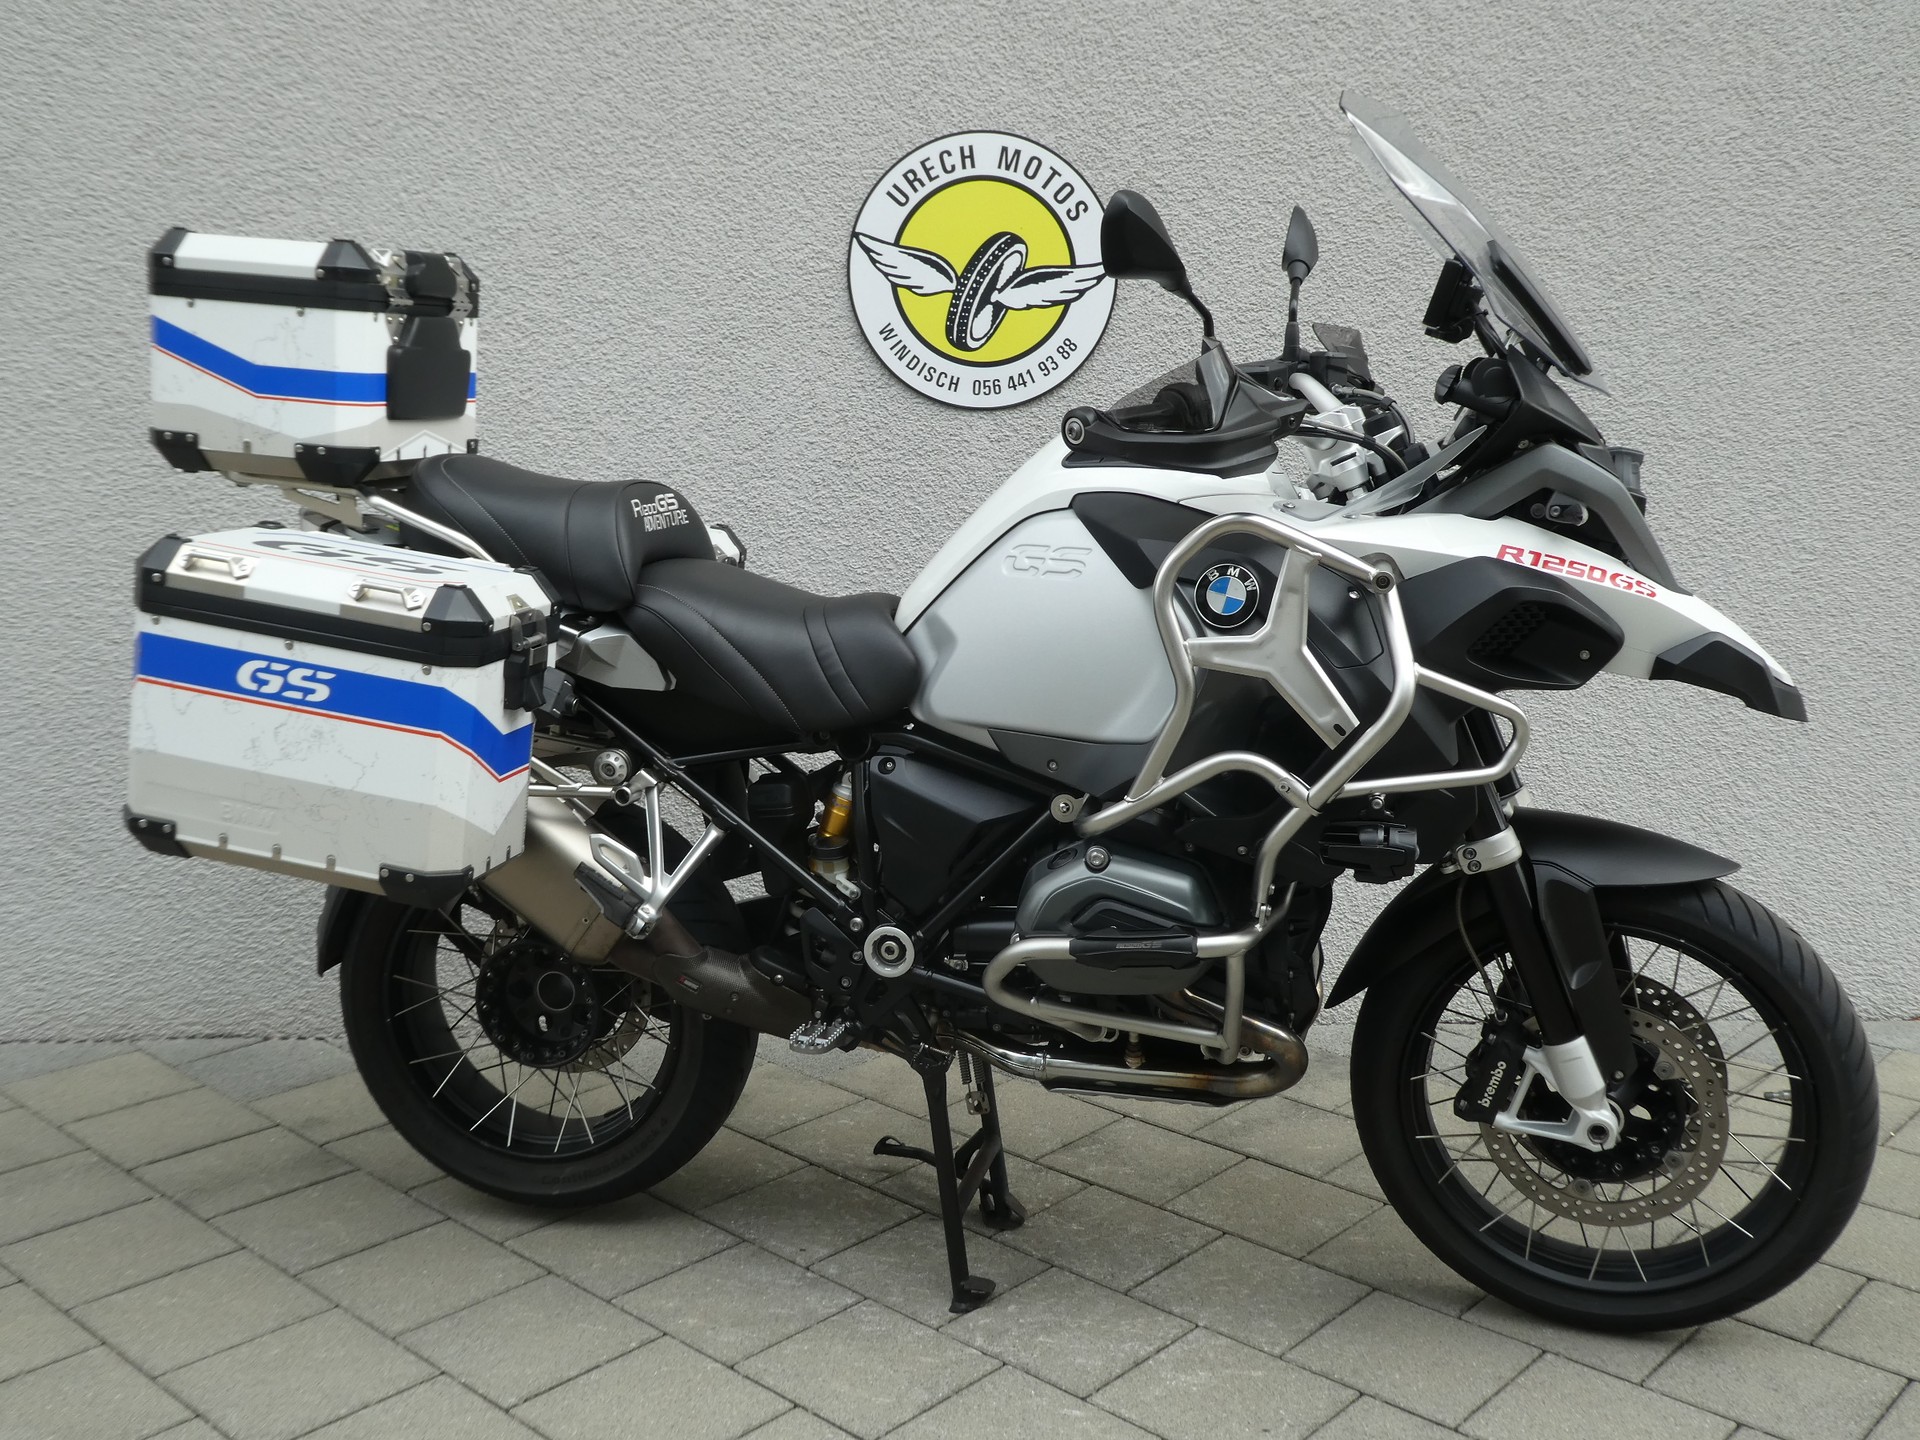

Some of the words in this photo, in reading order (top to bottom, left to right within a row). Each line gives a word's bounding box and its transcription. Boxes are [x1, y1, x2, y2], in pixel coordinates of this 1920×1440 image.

[885, 145, 976, 207] URECH
[997, 145, 1089, 221] MOTOS
[878, 322, 961, 393] WINDISCH
[972, 378, 1002, 396] 056
[1007, 368, 1037, 391] 441
[1038, 355, 1060, 377] 93
[1056, 337, 1079, 360] 88
[643, 509, 689, 532] ADVENTURE
[1206, 566, 1257, 591] BMW
[236, 659, 337, 702] GS
[1477, 1060, 1507, 1108] brembo
